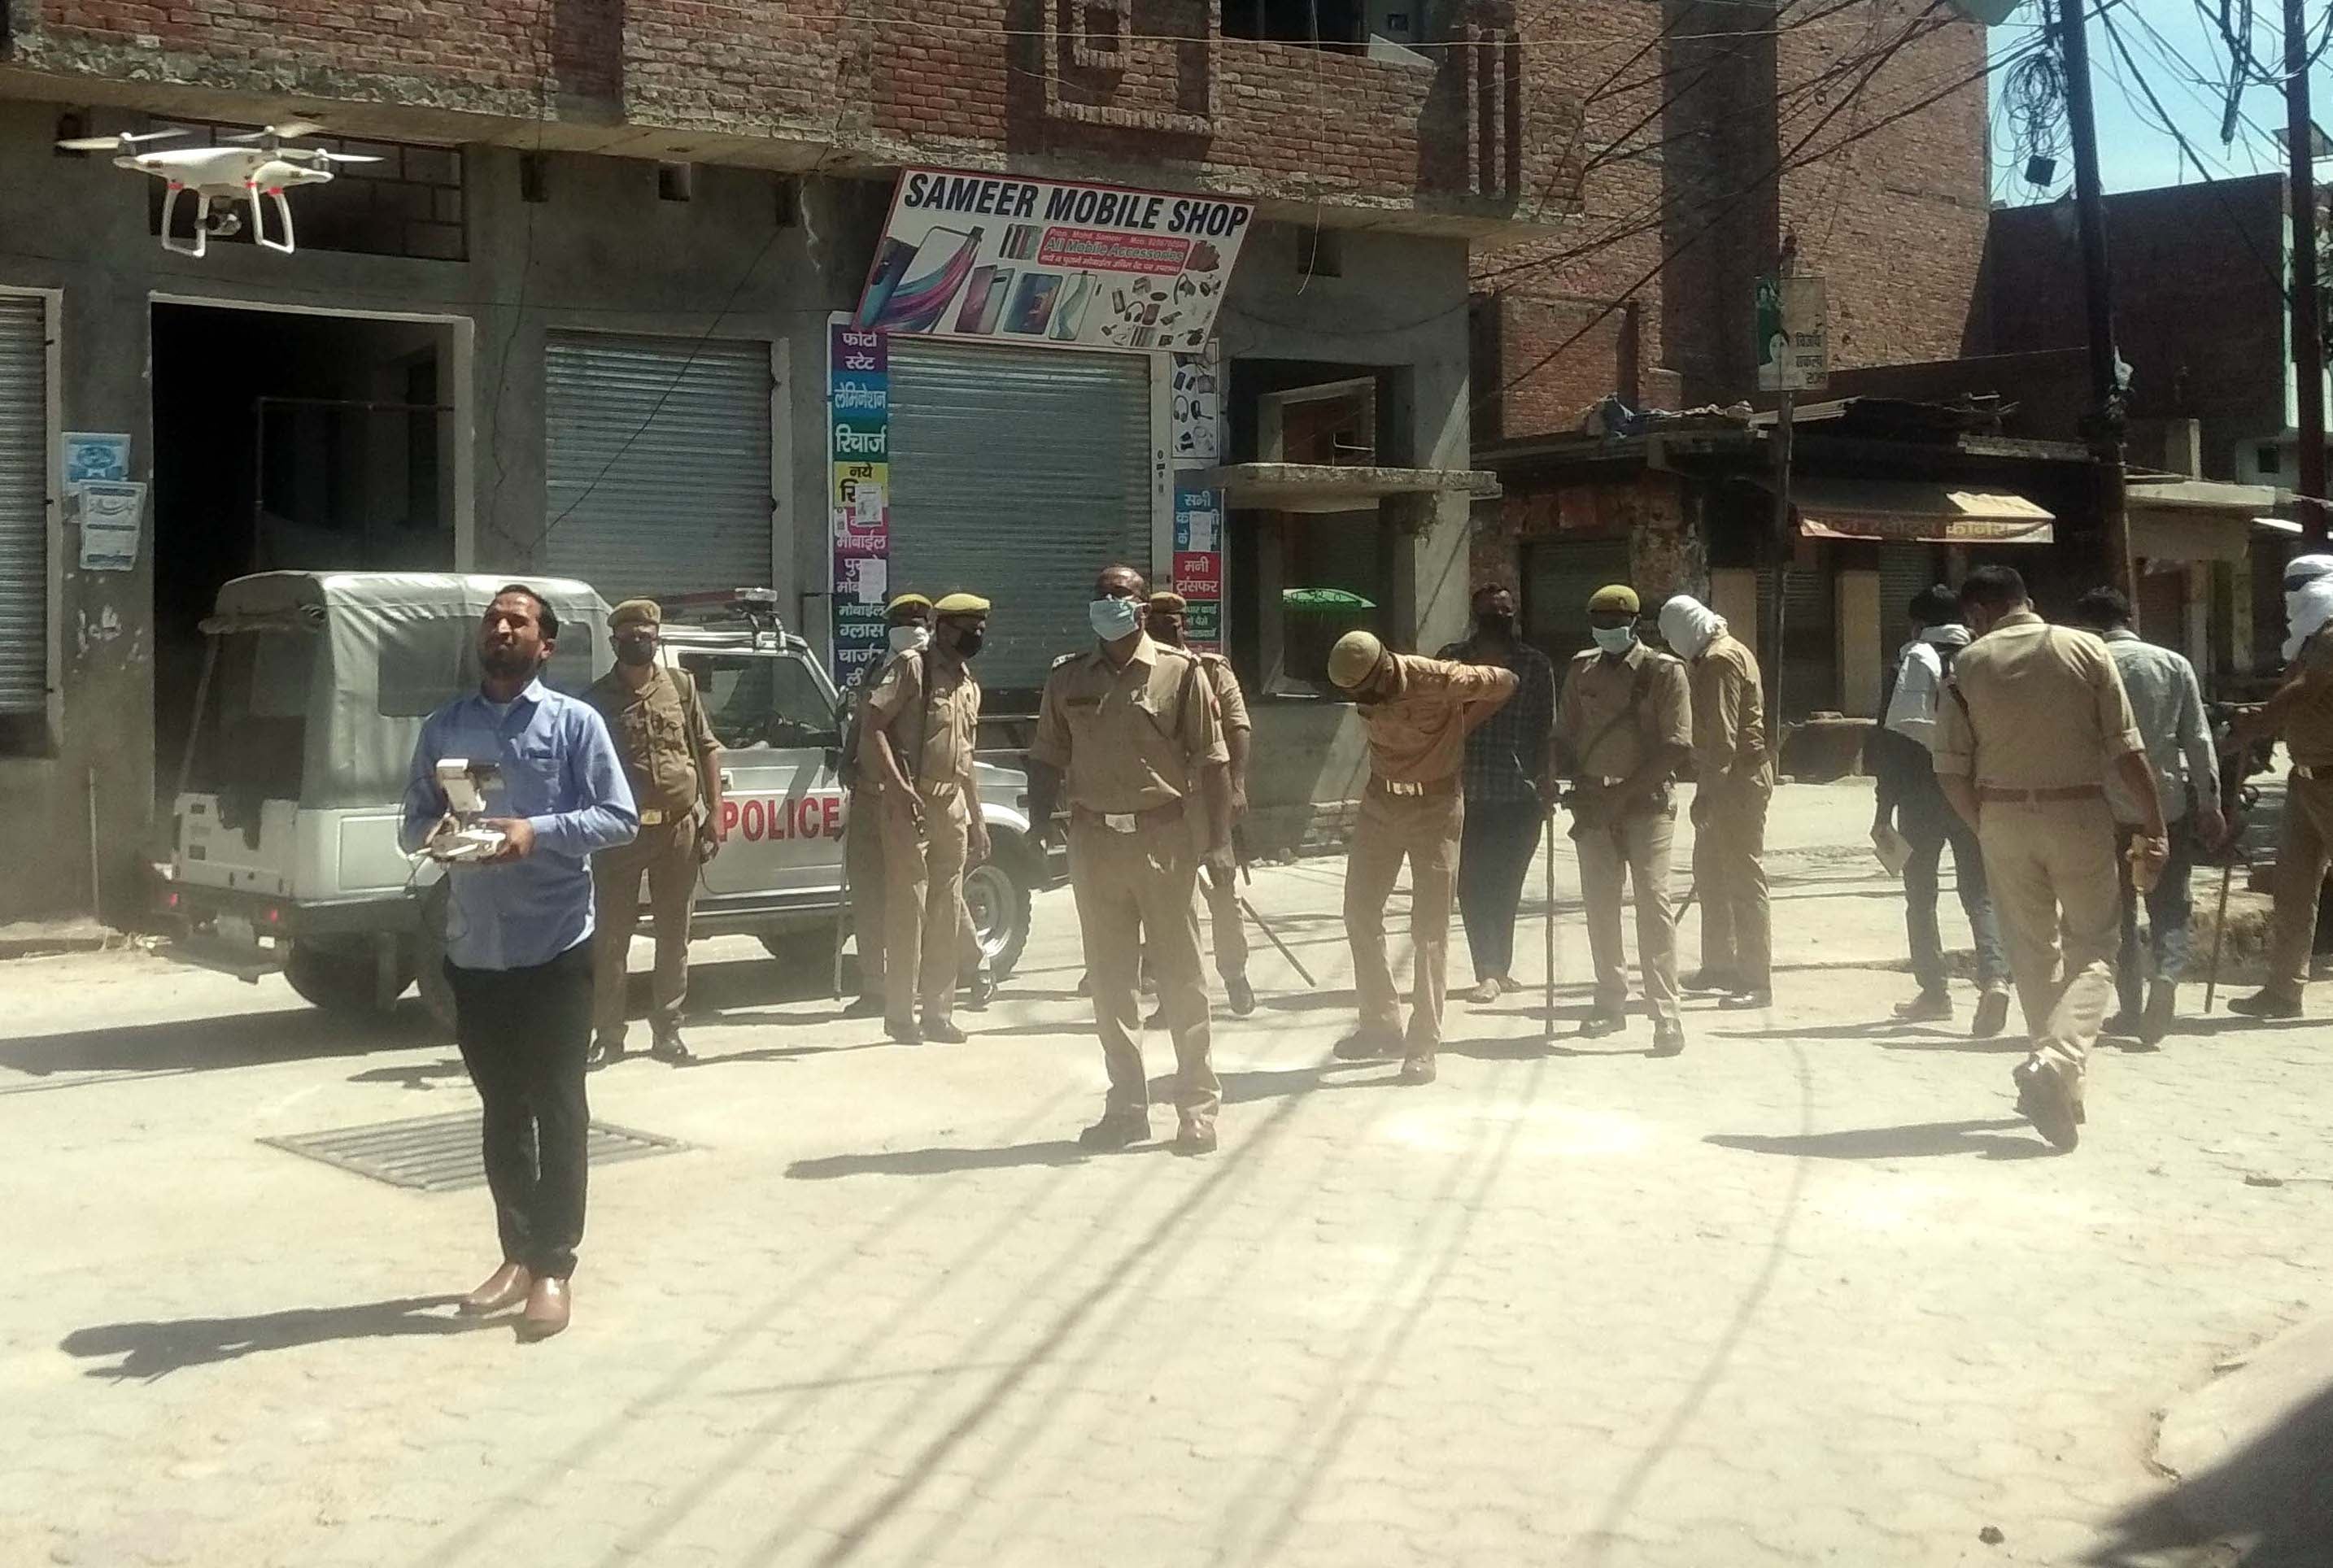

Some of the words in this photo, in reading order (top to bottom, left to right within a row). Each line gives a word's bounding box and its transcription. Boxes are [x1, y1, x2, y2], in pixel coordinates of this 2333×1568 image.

[905, 173, 1039, 217] SAMEER
[1044, 187, 1164, 229] MOBILE
[1167, 199, 1249, 237] SHOP
[1044, 237, 1065, 251] All
[1065, 239, 1107, 255] Mobile
[1107, 243, 1184, 263] Accessories
[842, 331, 878, 346] फोटो
[845, 351, 876, 370] स्टेट
[834, 381, 887, 408] लेमिनेशन
[835, 423, 887, 453] रिचार्ज
[848, 463, 873, 478] नये
[1184, 490, 1210, 507] सभी
[1184, 555, 1209, 573] मनी
[1175, 576, 1219, 595] ट्रांसफर
[839, 603, 885, 617] मोबाईल
[839, 624, 885, 638] ग्लास
[719, 797, 840, 843] POLICE
